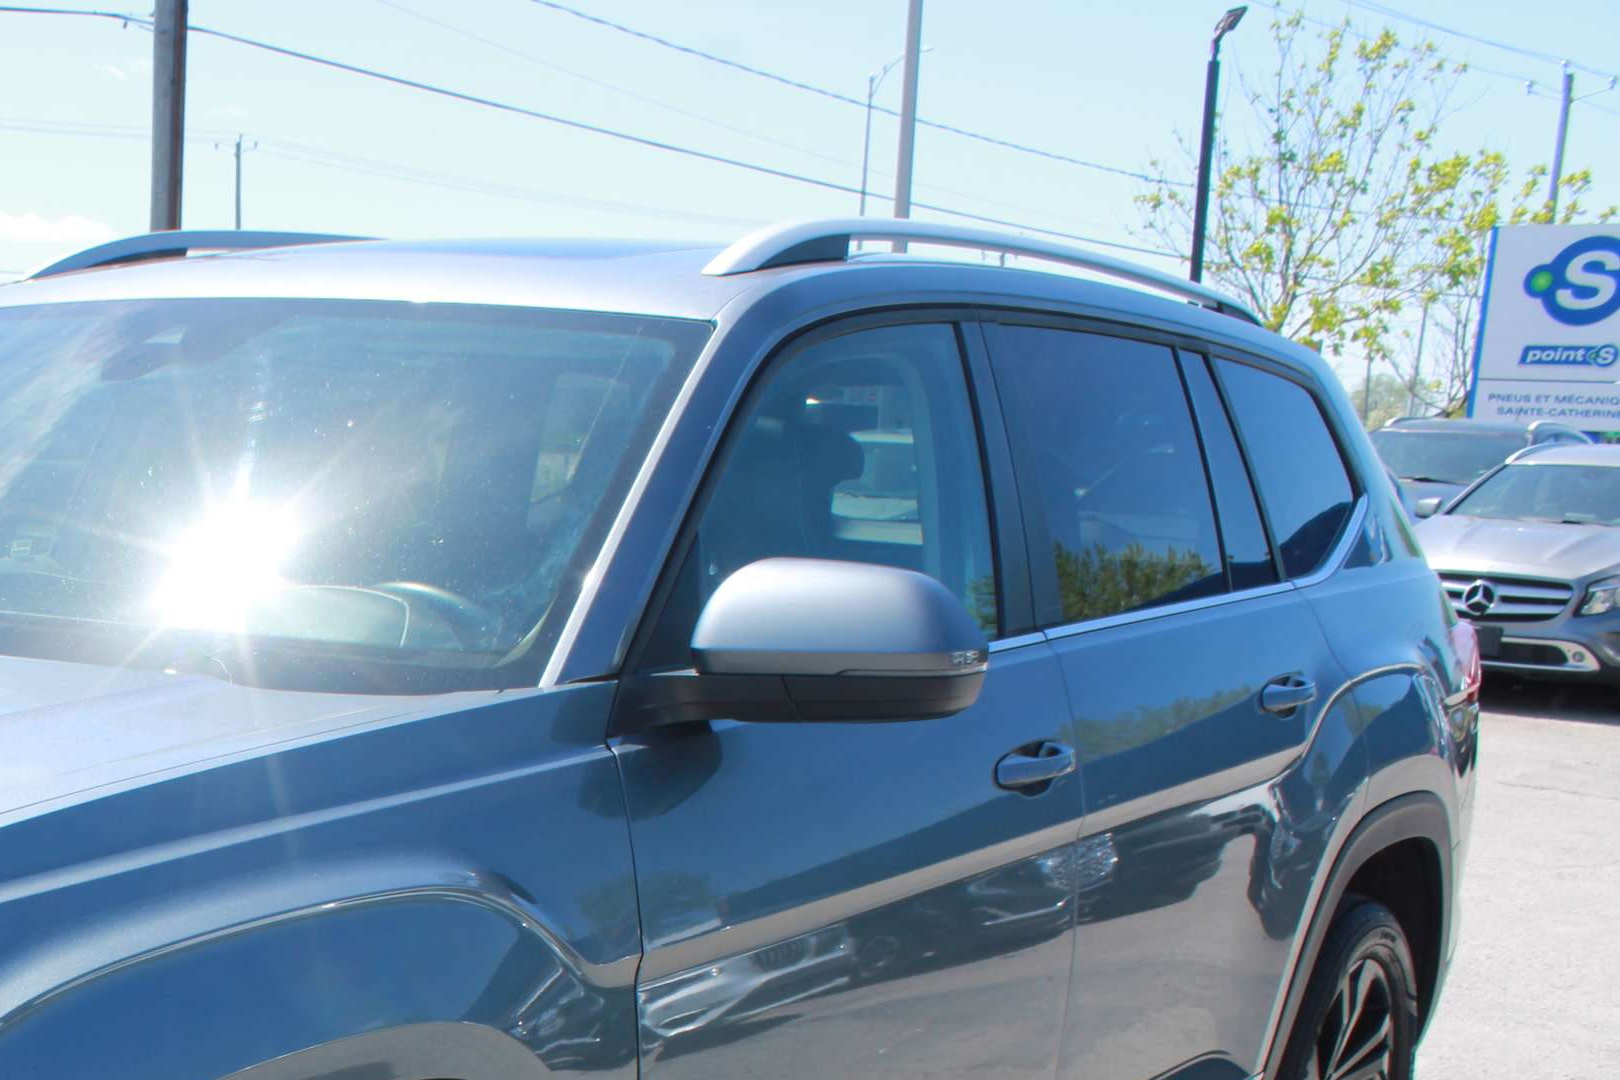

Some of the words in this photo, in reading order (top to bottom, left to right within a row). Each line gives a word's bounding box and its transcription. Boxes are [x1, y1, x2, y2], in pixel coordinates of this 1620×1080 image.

[1525, 347, 1586, 364] point
[1488, 392, 1532, 404] PNEUS
[1535, 394, 1551, 404] ET
